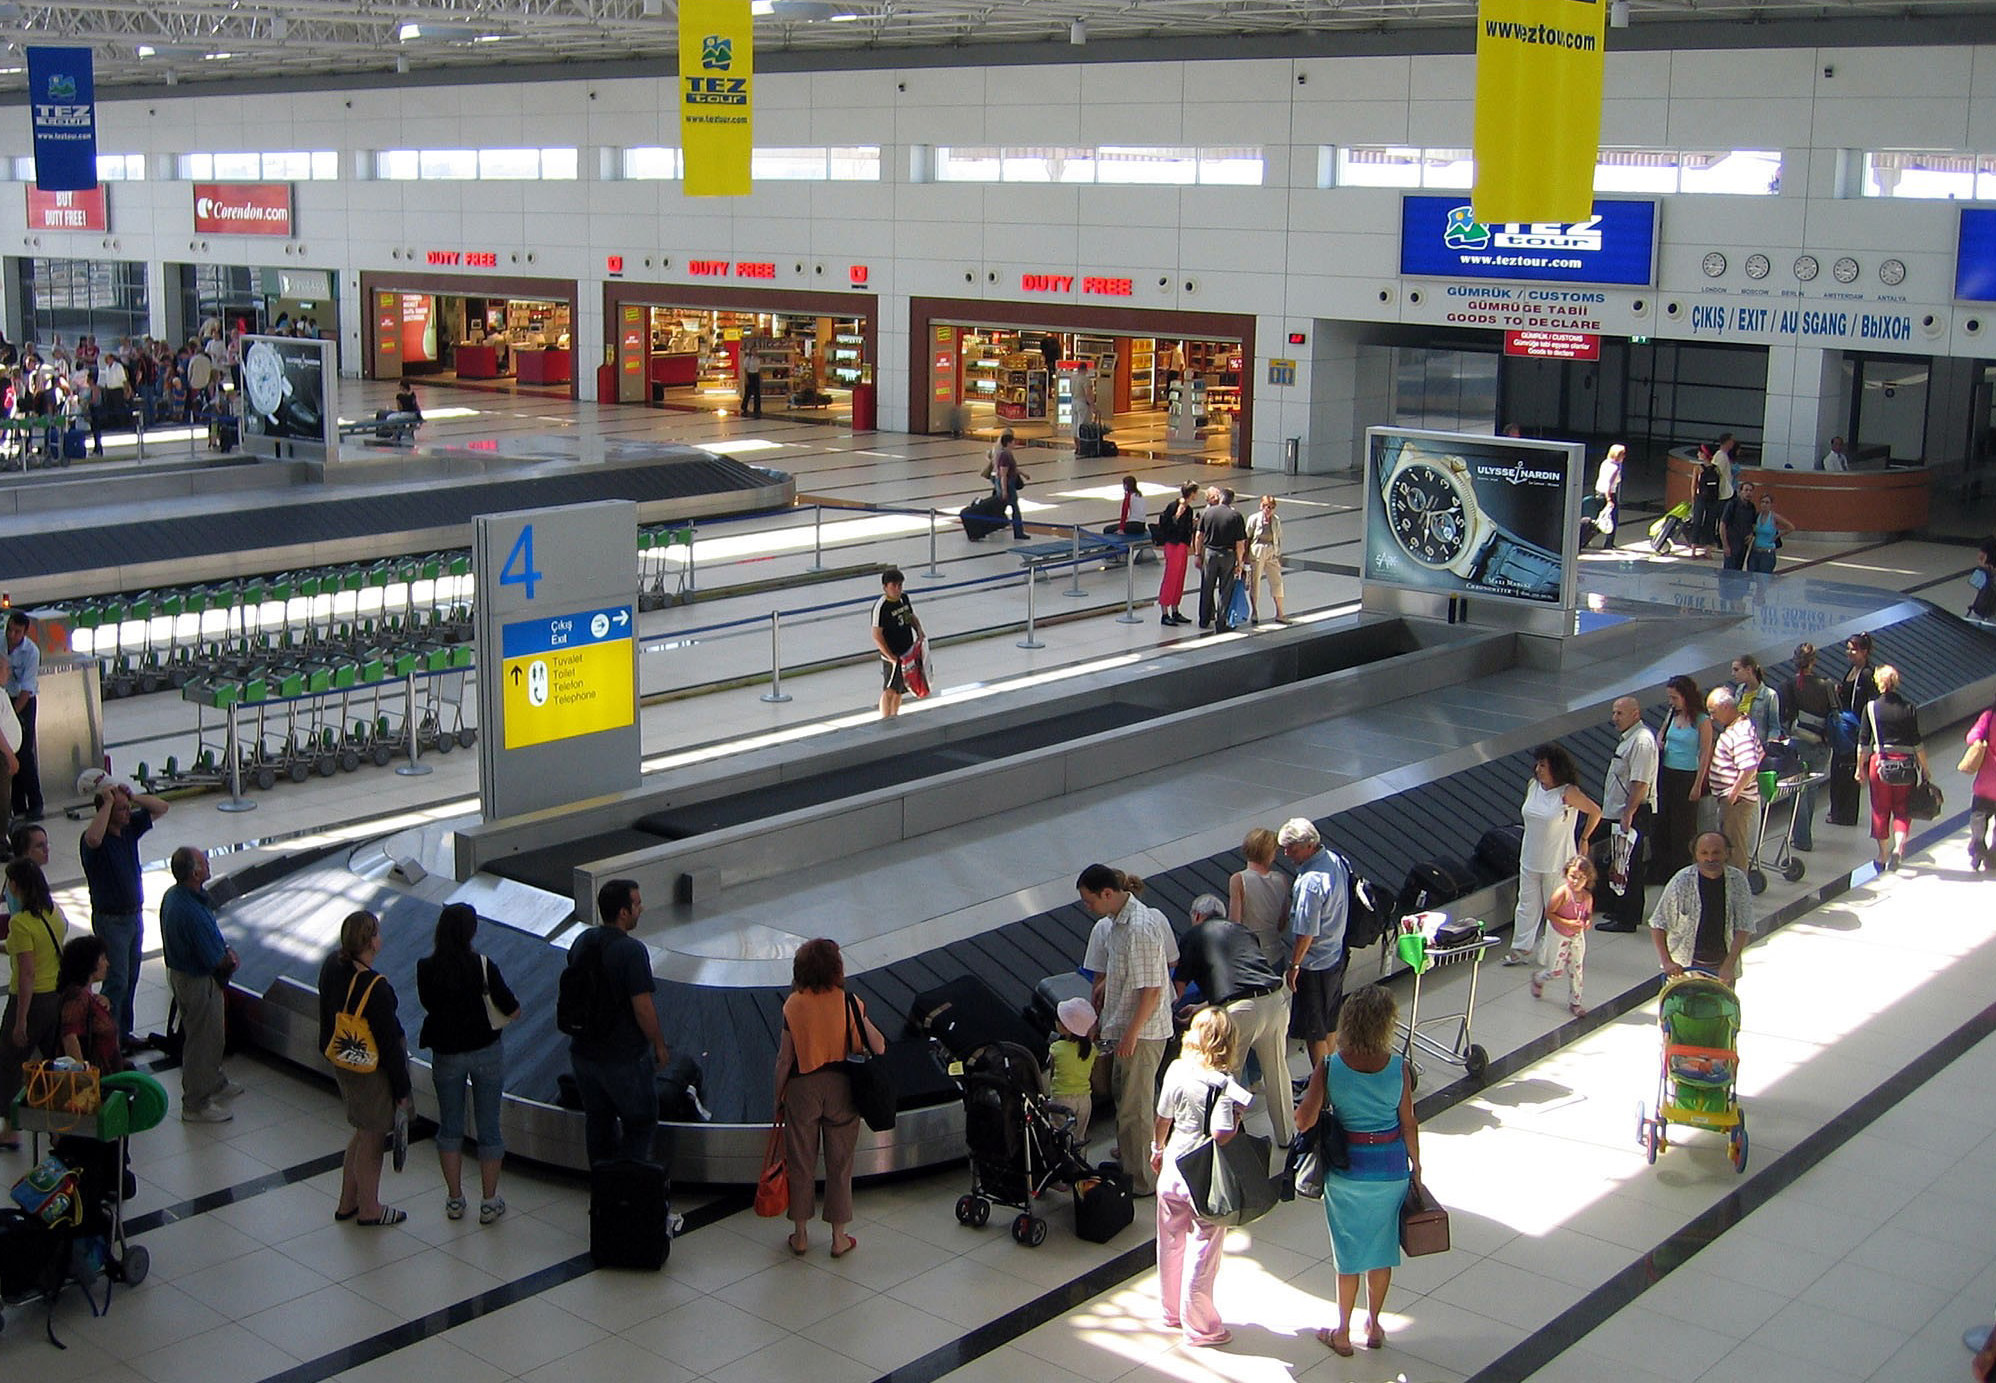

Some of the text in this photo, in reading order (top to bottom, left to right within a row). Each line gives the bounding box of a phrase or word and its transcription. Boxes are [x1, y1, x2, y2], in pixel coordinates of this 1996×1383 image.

[686, 76, 747, 93] TEZ
[694, 94, 742, 104] tour
[35, 104, 91, 117] TEZ
[56, 190, 73, 207] BUY
[44, 209, 63, 226] DUTY
[213, 201, 288, 221] Corendon.com
[1507, 236, 1589, 247] tour
[426, 251, 496, 268] DUTY FREE
[1459, 255, 1582, 269] www.teztour.com
[688, 260, 775, 279] DUTY FREE
[1022, 274, 1132, 297] DUTY FREE
[1701, 286, 1728, 294] LONDON
[1447, 286, 1512, 299] GÜMRÜK
[1528, 290, 1606, 303] CUSTOMS
[1823, 292, 1864, 300] AMSTERDAM
[1877, 294, 1907, 302] ANTALYA
[1447, 313, 1497, 325] GOODS
[1503, 316, 1523, 326] TO
[1692, 305, 1725, 335] ÇIKIŞ
[1738, 308, 1768, 332] EXIT
[1477, 466, 1561, 481] ULYSSE NARDIN
[499, 524, 543, 600] 4
[551, 619, 573, 633] Çıkış
[551, 633, 568, 645] Exit
[552, 654, 583, 667] Tuvalet
[553, 667, 576, 679] Toilet
[553, 680, 584, 692] Telefon
[553, 691, 597, 705] Telephone
